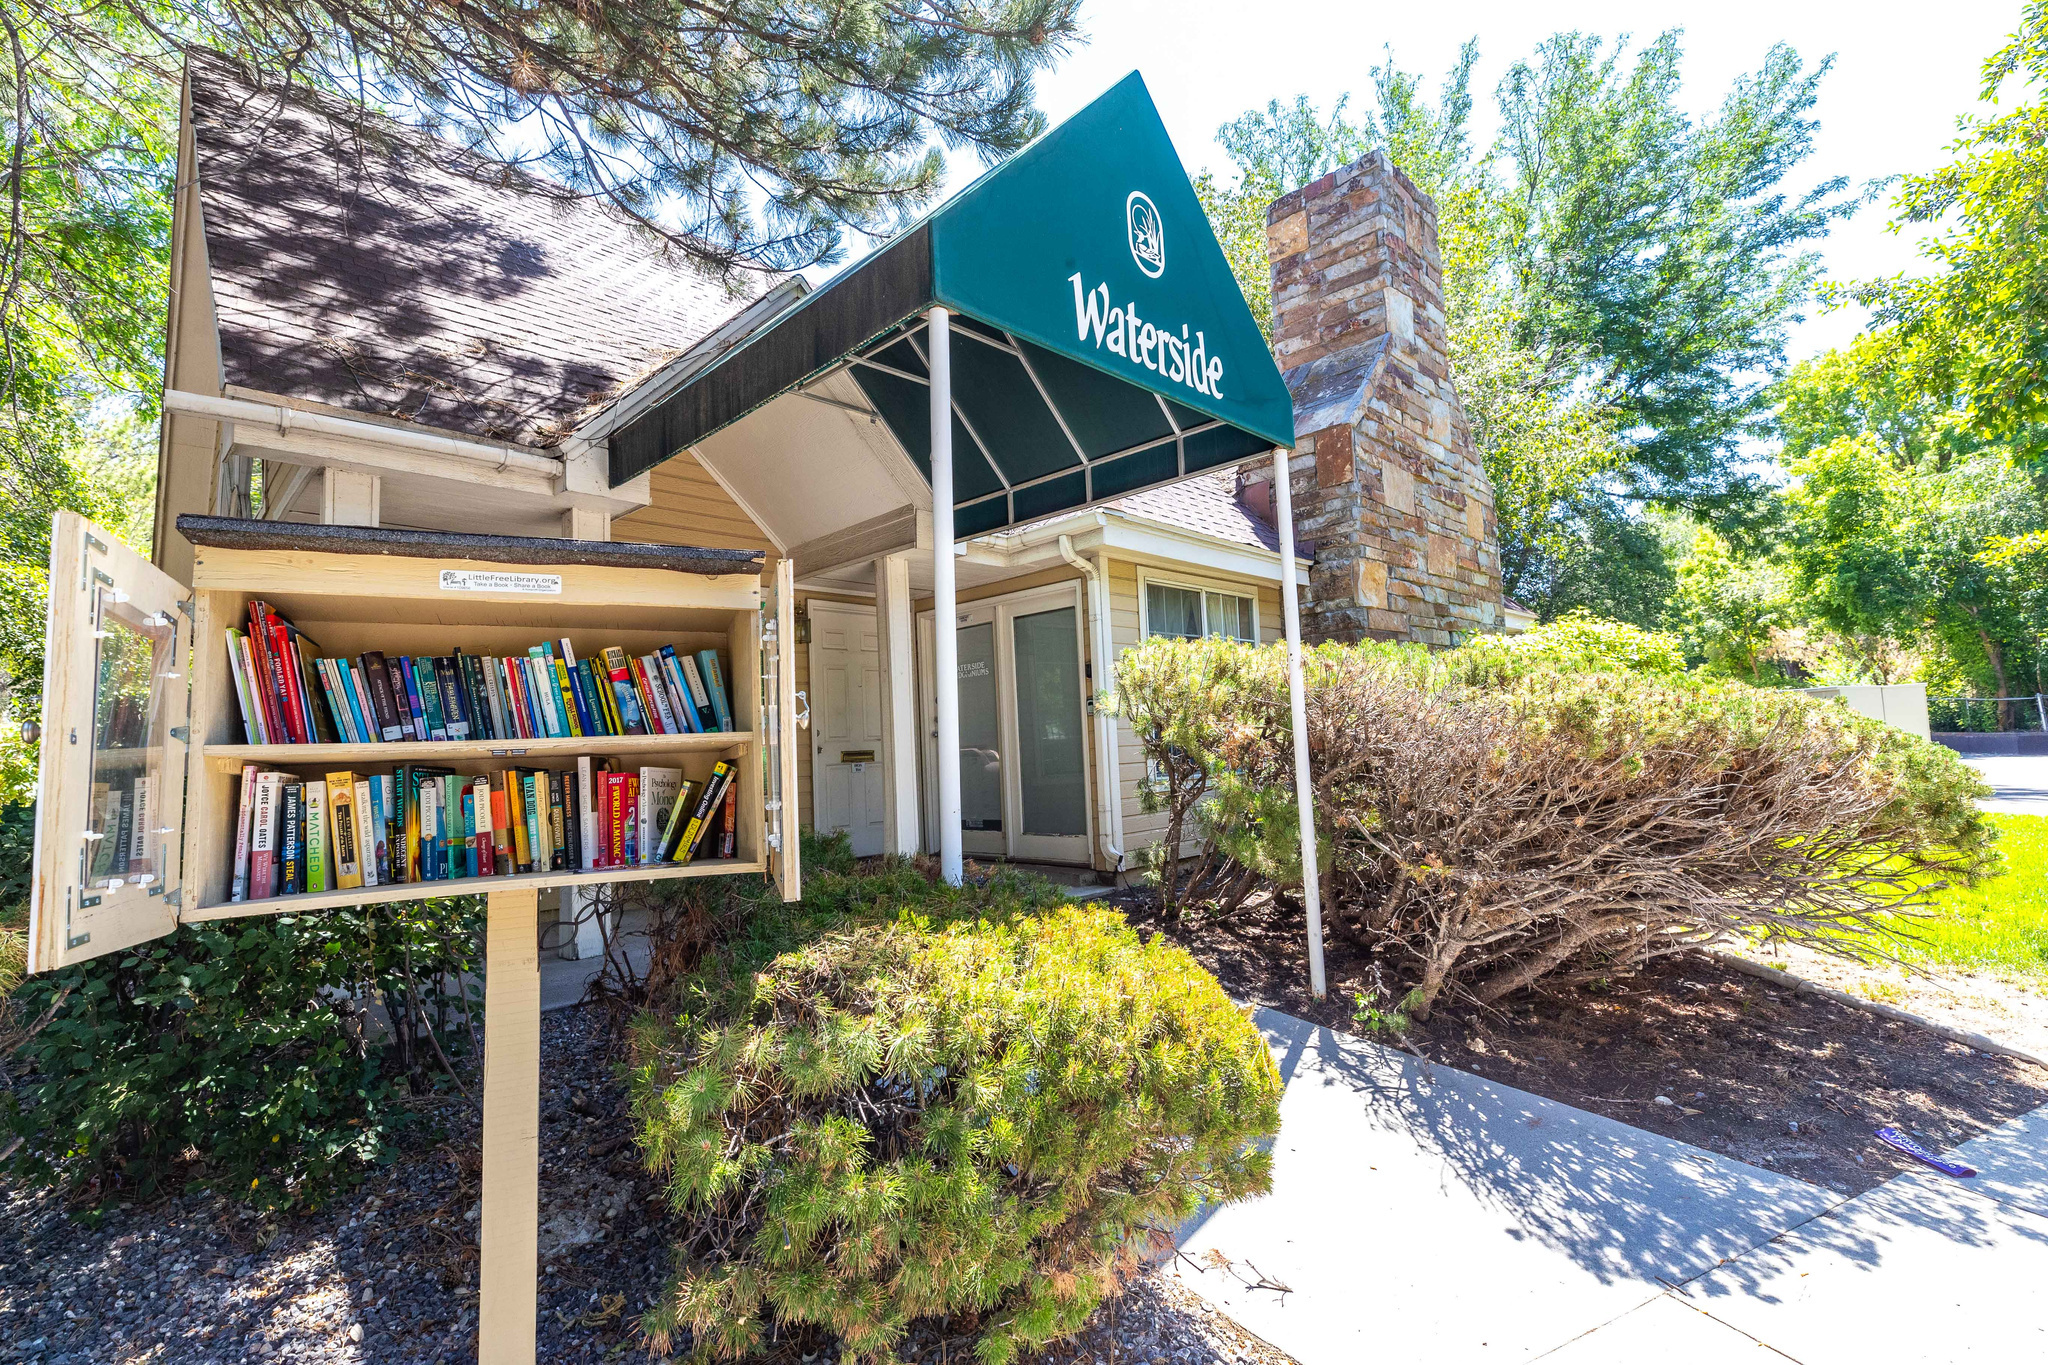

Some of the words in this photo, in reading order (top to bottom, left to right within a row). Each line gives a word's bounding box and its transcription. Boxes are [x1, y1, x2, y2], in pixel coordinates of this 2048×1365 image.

[1068, 272, 1224, 400] Waterside
[468, 574, 556, 585] LittleFreeLibrary.org
[273, 657, 284, 684] FOOLED
[708, 657, 722, 688] untamed
[957, 661, 985, 672] ATERSIDE
[376, 678, 384, 693] ATTACK
[428, 680, 438, 695] PETER
[641, 676, 650, 694] CAPTAIN
[653, 682, 667, 706] SCHOOL
[422, 681, 435, 713] STARCATCHERS
[444, 681, 460, 721] FABLEHAVEN
[543, 691, 551, 705] HULA
[571, 713, 579, 729] SCHOOL
[588, 697, 600, 720] LIGHTNING
[594, 719, 603, 733] THIEF
[394, 768, 403, 798] STUART
[524, 781, 535, 799] IVAN
[608, 776, 624, 784] 2017
[651, 778, 677, 790] Psychology
[702, 774, 719, 801] Investing
[259, 784, 270, 805] JOYCE
[359, 791, 368, 814] stalking
[423, 789, 431, 805] JODI
[477, 788, 485, 802] JODI
[611, 790, 620, 818] WORLD
[651, 791, 676, 806] Money
[258, 805, 268, 827] CAROL
[286, 795, 296, 818] JAMES
[395, 797, 404, 827] WOODS
[478, 802, 486, 828] PICOULT
[526, 800, 536, 815] DOIG
[552, 808, 560, 824] RULES
[695, 798, 709, 819] Online
[237, 804, 247, 841] Fundamentally
[361, 813, 369, 823] the
[528, 818, 536, 834] SWEET
[257, 827, 267, 849] OATES
[285, 819, 295, 860] PATTERSON
[309, 811, 319, 872] MATCHED
[345, 828, 353, 850] FOLLETT
[363, 824, 371, 838] wild
[553, 826, 561, 846] CIVILITY
[612, 819, 620, 857] ALMANAC
[237, 841, 245, 860] Female
[363, 838, 373, 867] asparagus
[399, 833, 407, 867] INDECENT
[530, 835, 538, 857] THUNDER
[262, 852, 268, 862] WE
[285, 860, 294, 881] STEAL
